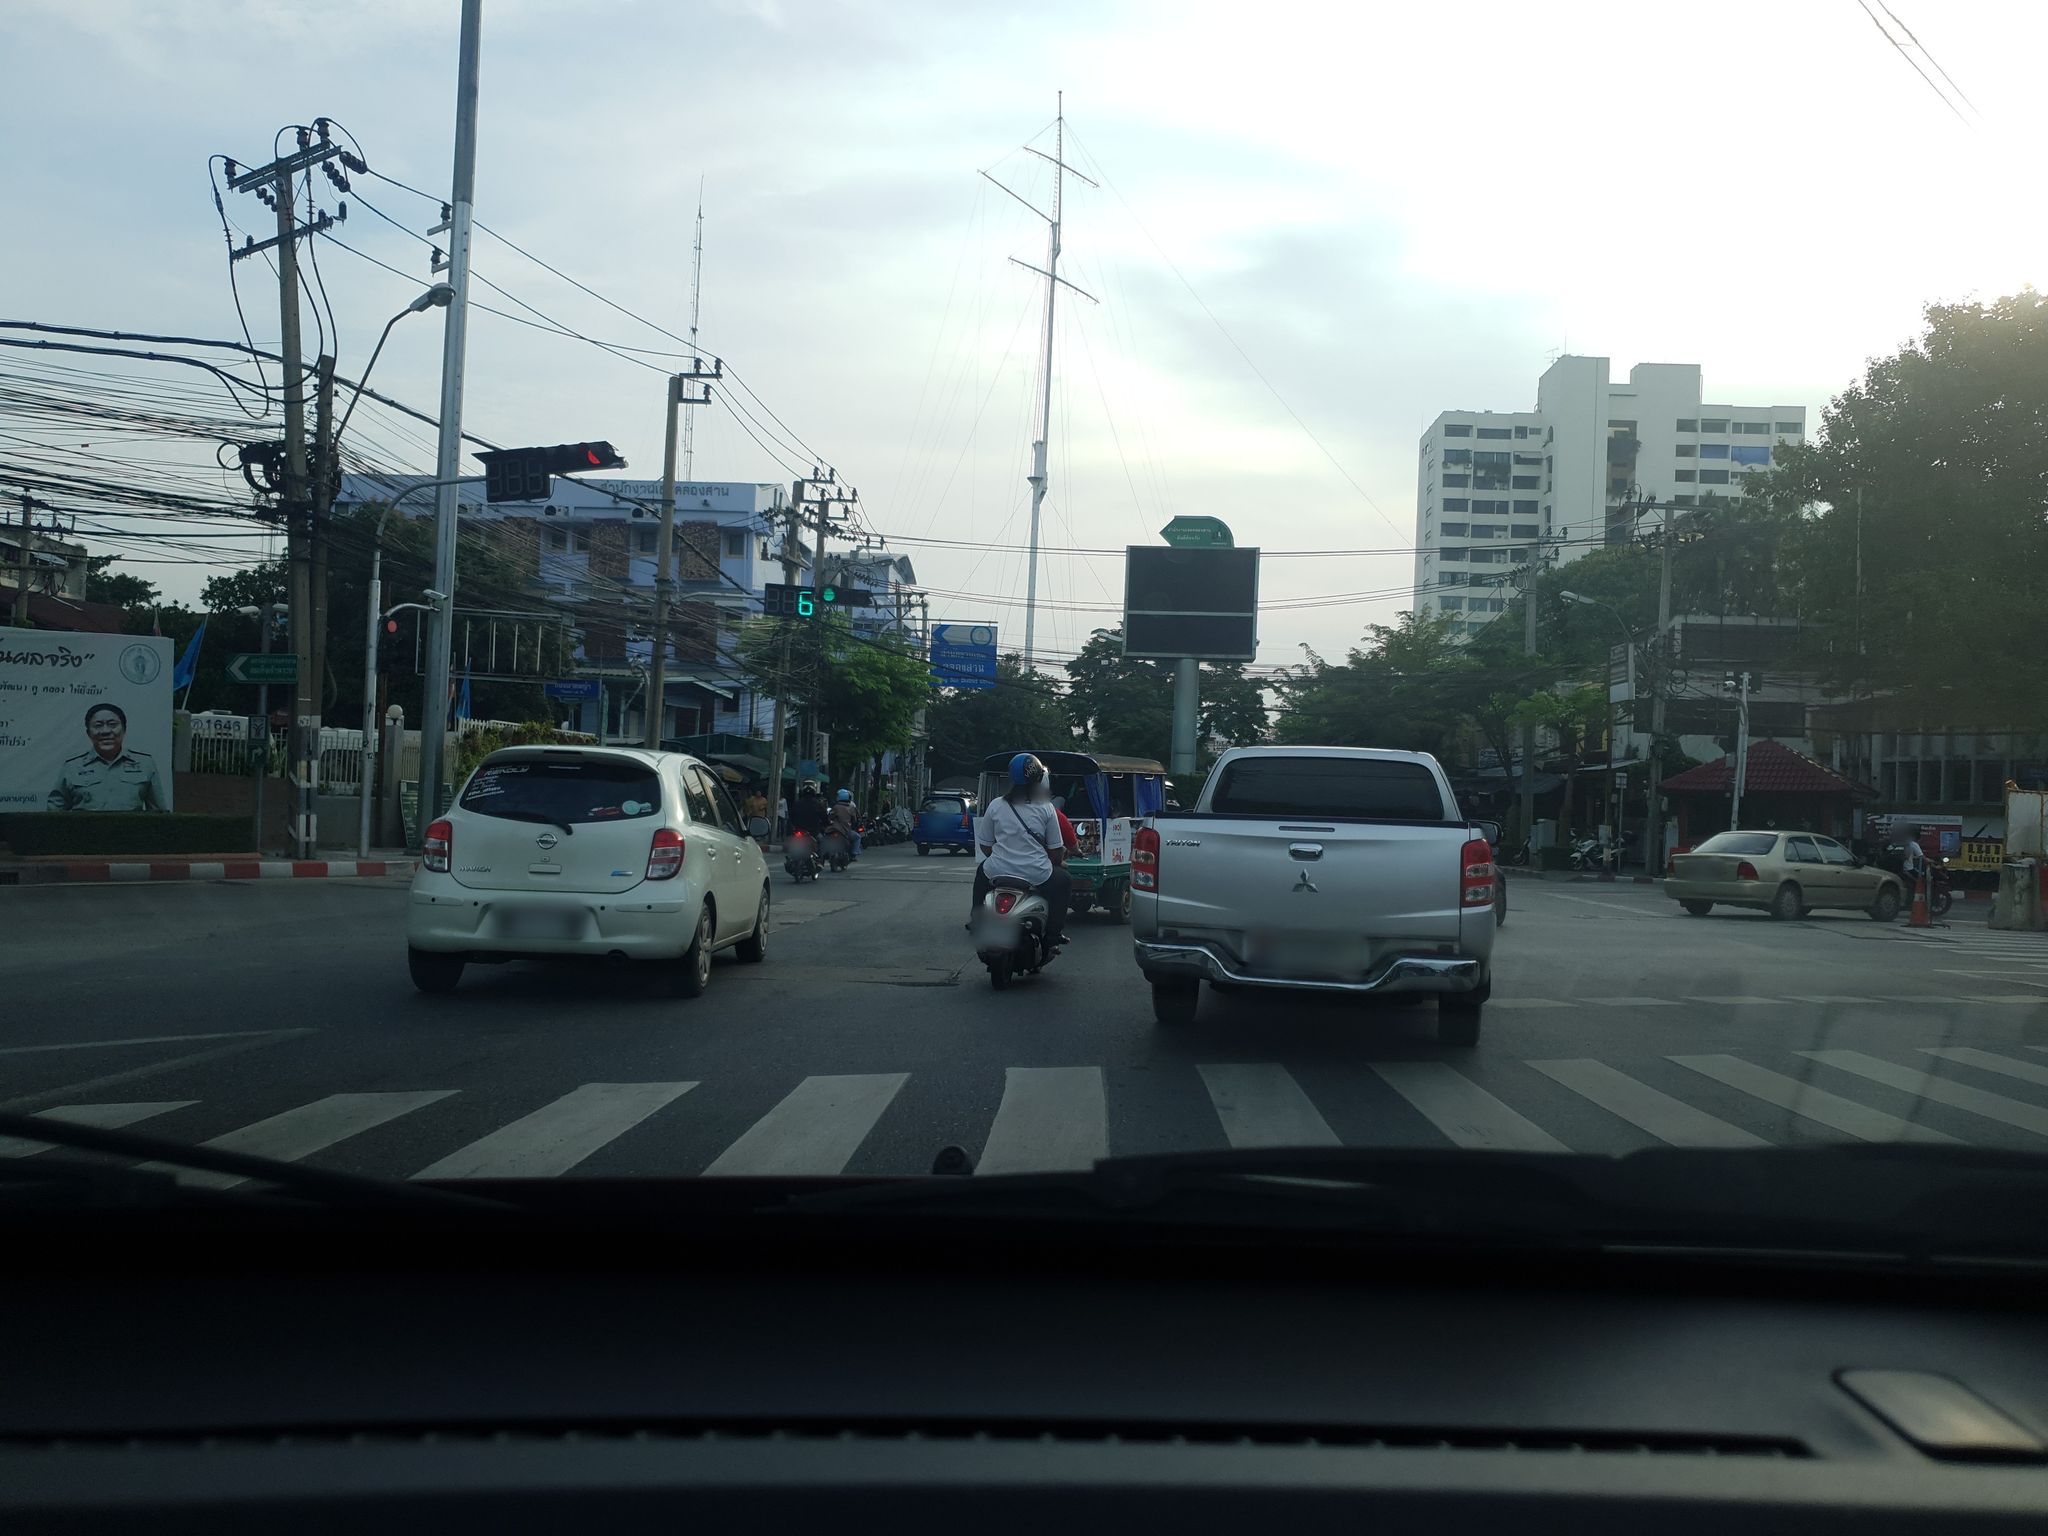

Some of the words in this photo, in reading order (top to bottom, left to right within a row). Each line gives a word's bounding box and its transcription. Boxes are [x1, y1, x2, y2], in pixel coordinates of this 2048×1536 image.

[798, 591, 813, 616] 6
[206, 719, 241, 732] 1646
[1165, 838, 1202, 848] TRITON
[459, 864, 492, 874] MARCH
